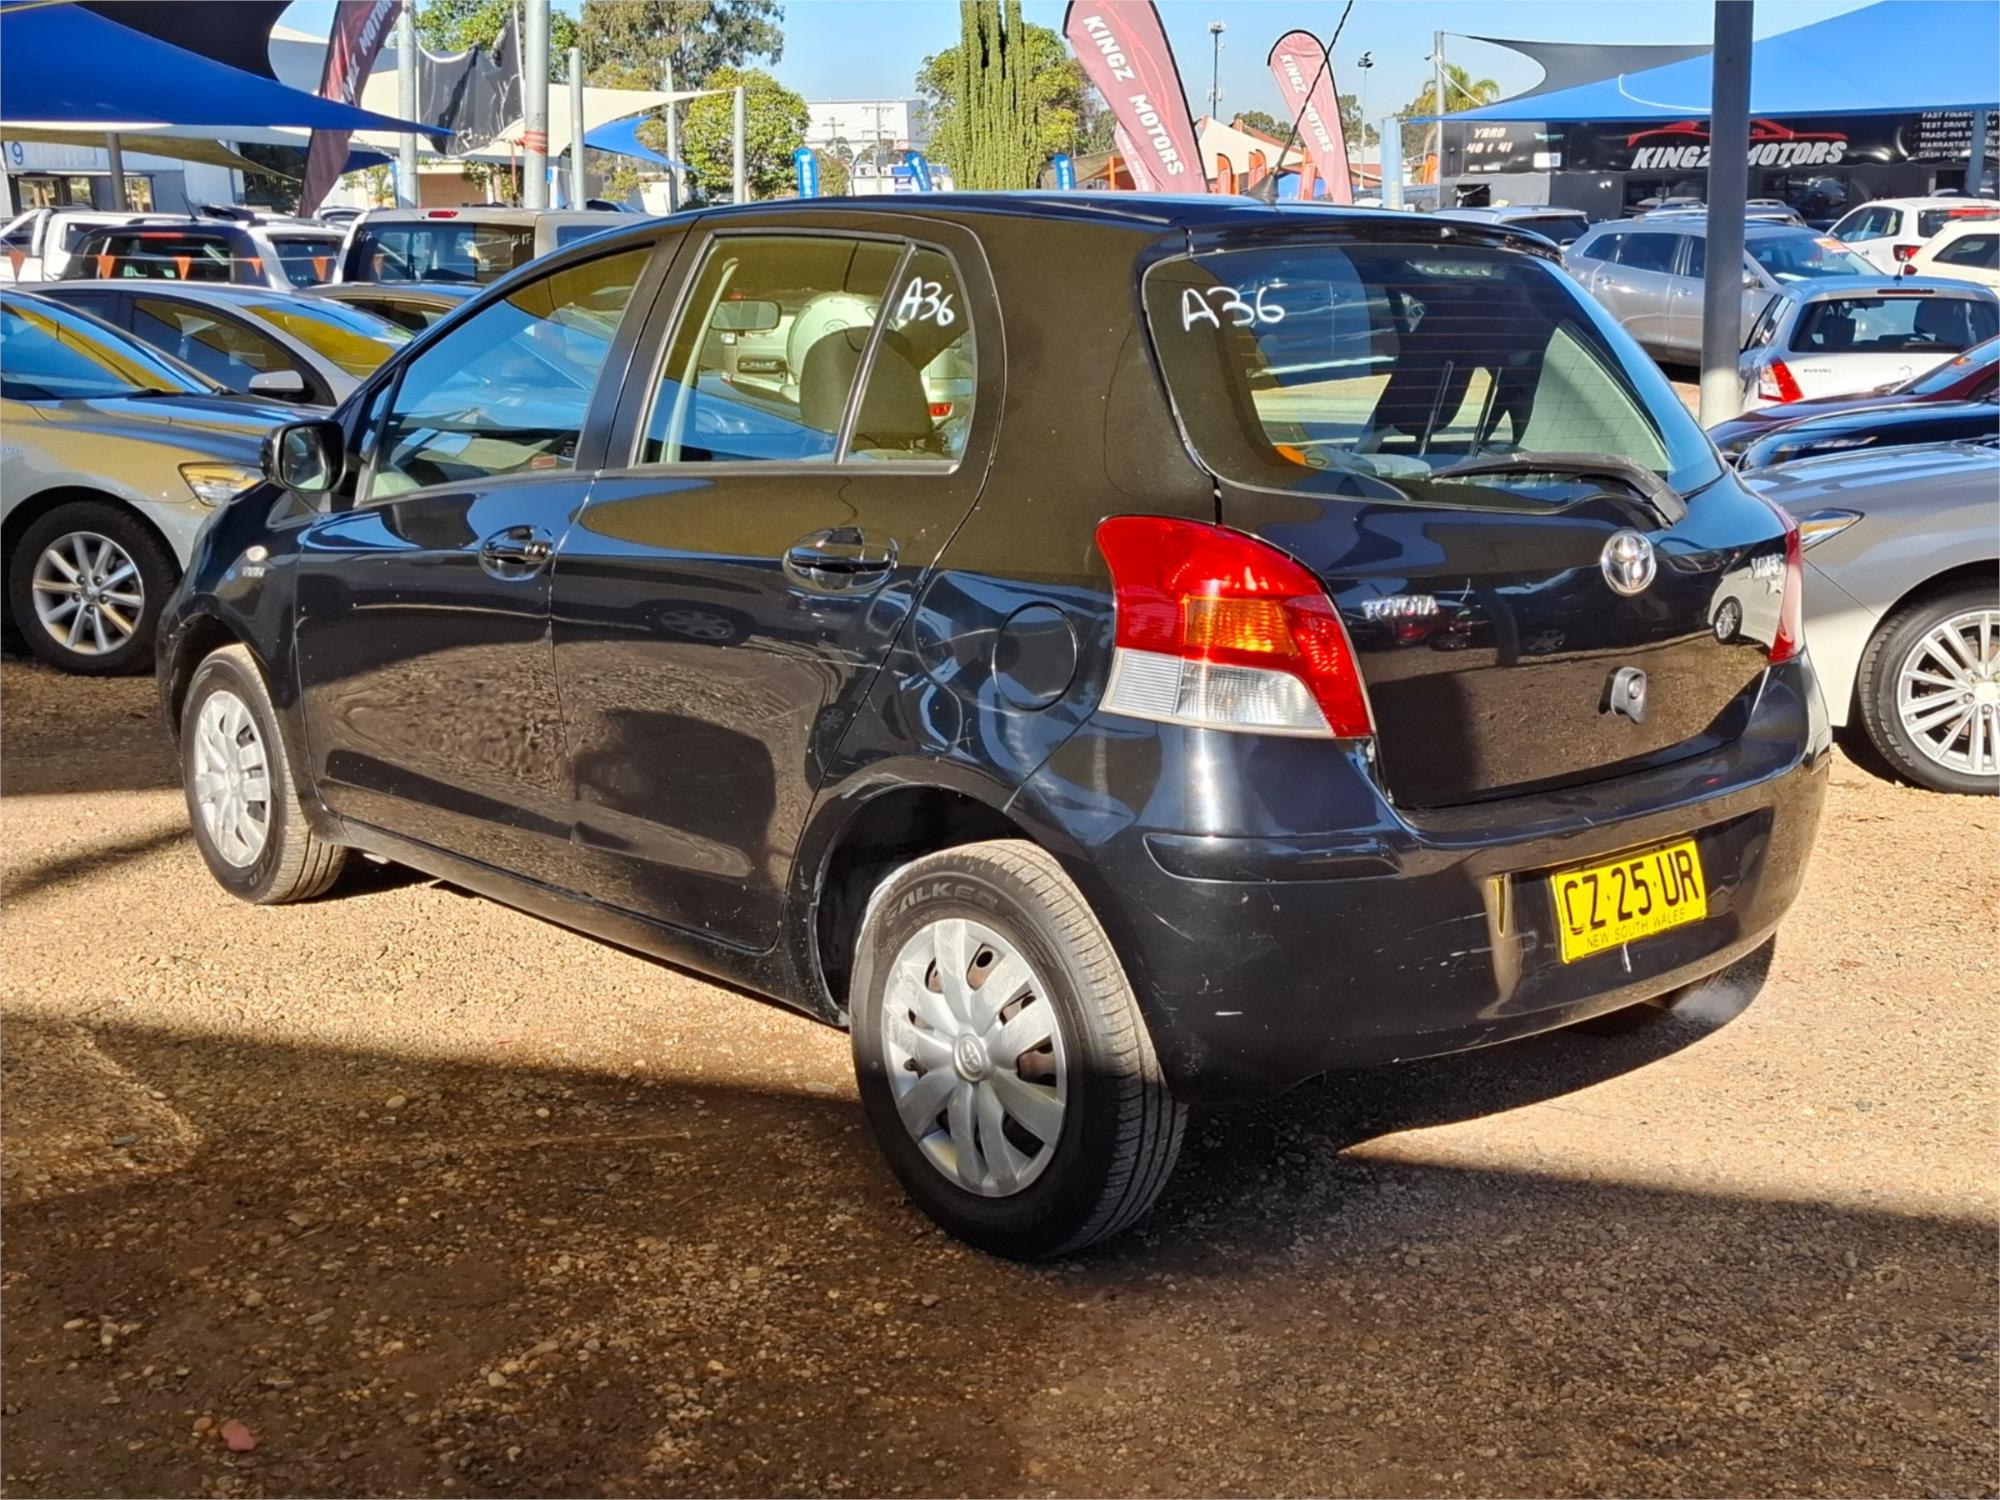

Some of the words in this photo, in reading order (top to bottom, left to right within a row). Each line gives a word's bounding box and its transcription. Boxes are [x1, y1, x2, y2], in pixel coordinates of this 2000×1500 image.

[1280, 54, 1307, 94] KINGZ
[1082, 15, 1136, 82] KINGZ
[1128, 94, 1185, 176] MOTORS
[1943, 121, 1967, 129] DRIVE
[1945, 110, 1974, 118] FINANC
[1474, 127, 1506, 139] YARD
[1920, 131, 1963, 139] TRADE-INS
[1920, 140, 1972, 148] WARRANTIES
[12, 141, 24, 166] 9
[1466, 142, 1484, 154] 40
[1498, 142, 1513, 153] 41
[897, 276, 956, 327] A36
[1182, 286, 1285, 331] A36
[1361, 595, 1439, 619] TOYOTA
[1614, 920, 1649, 939] SOUTH
[1653, 907, 1686, 927] WALES
